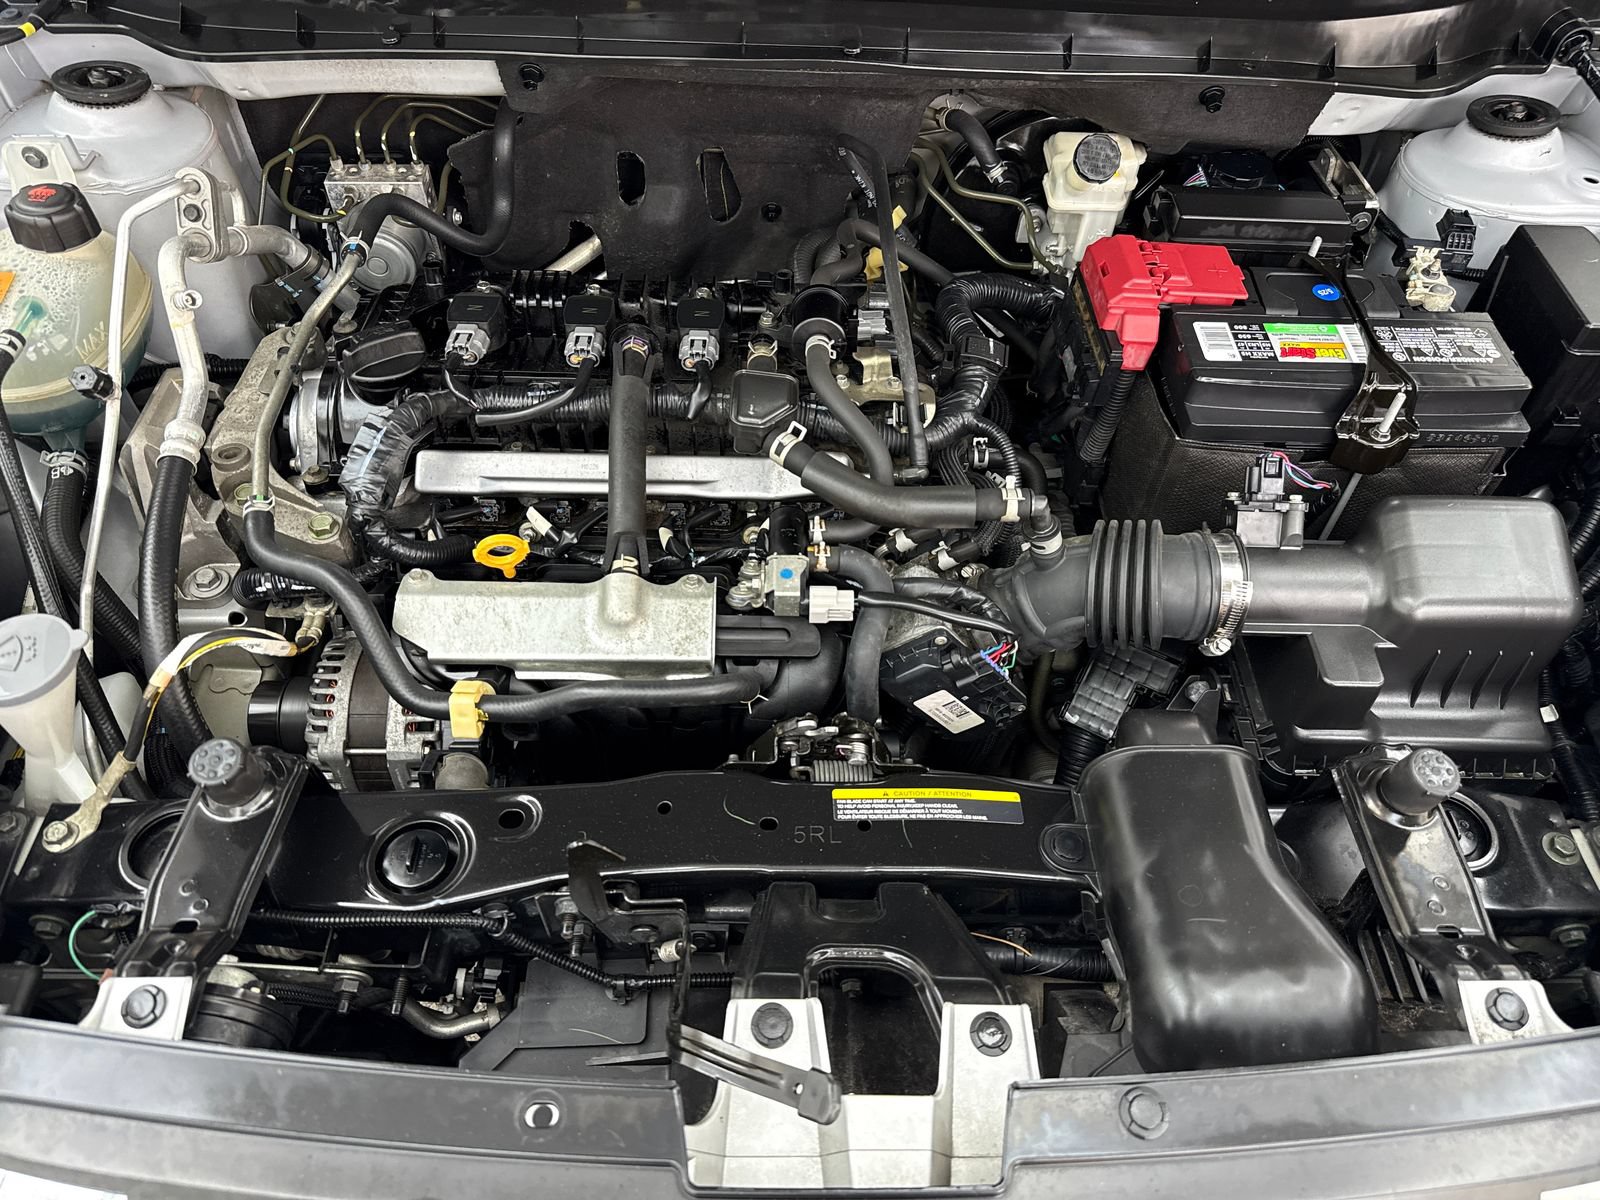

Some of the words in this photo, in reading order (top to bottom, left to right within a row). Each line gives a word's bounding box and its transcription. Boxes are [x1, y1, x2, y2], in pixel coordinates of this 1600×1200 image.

[75, 319, 108, 361] MAX
[1279, 346, 1348, 361] EverStart
[793, 825, 843, 844] 5RL
